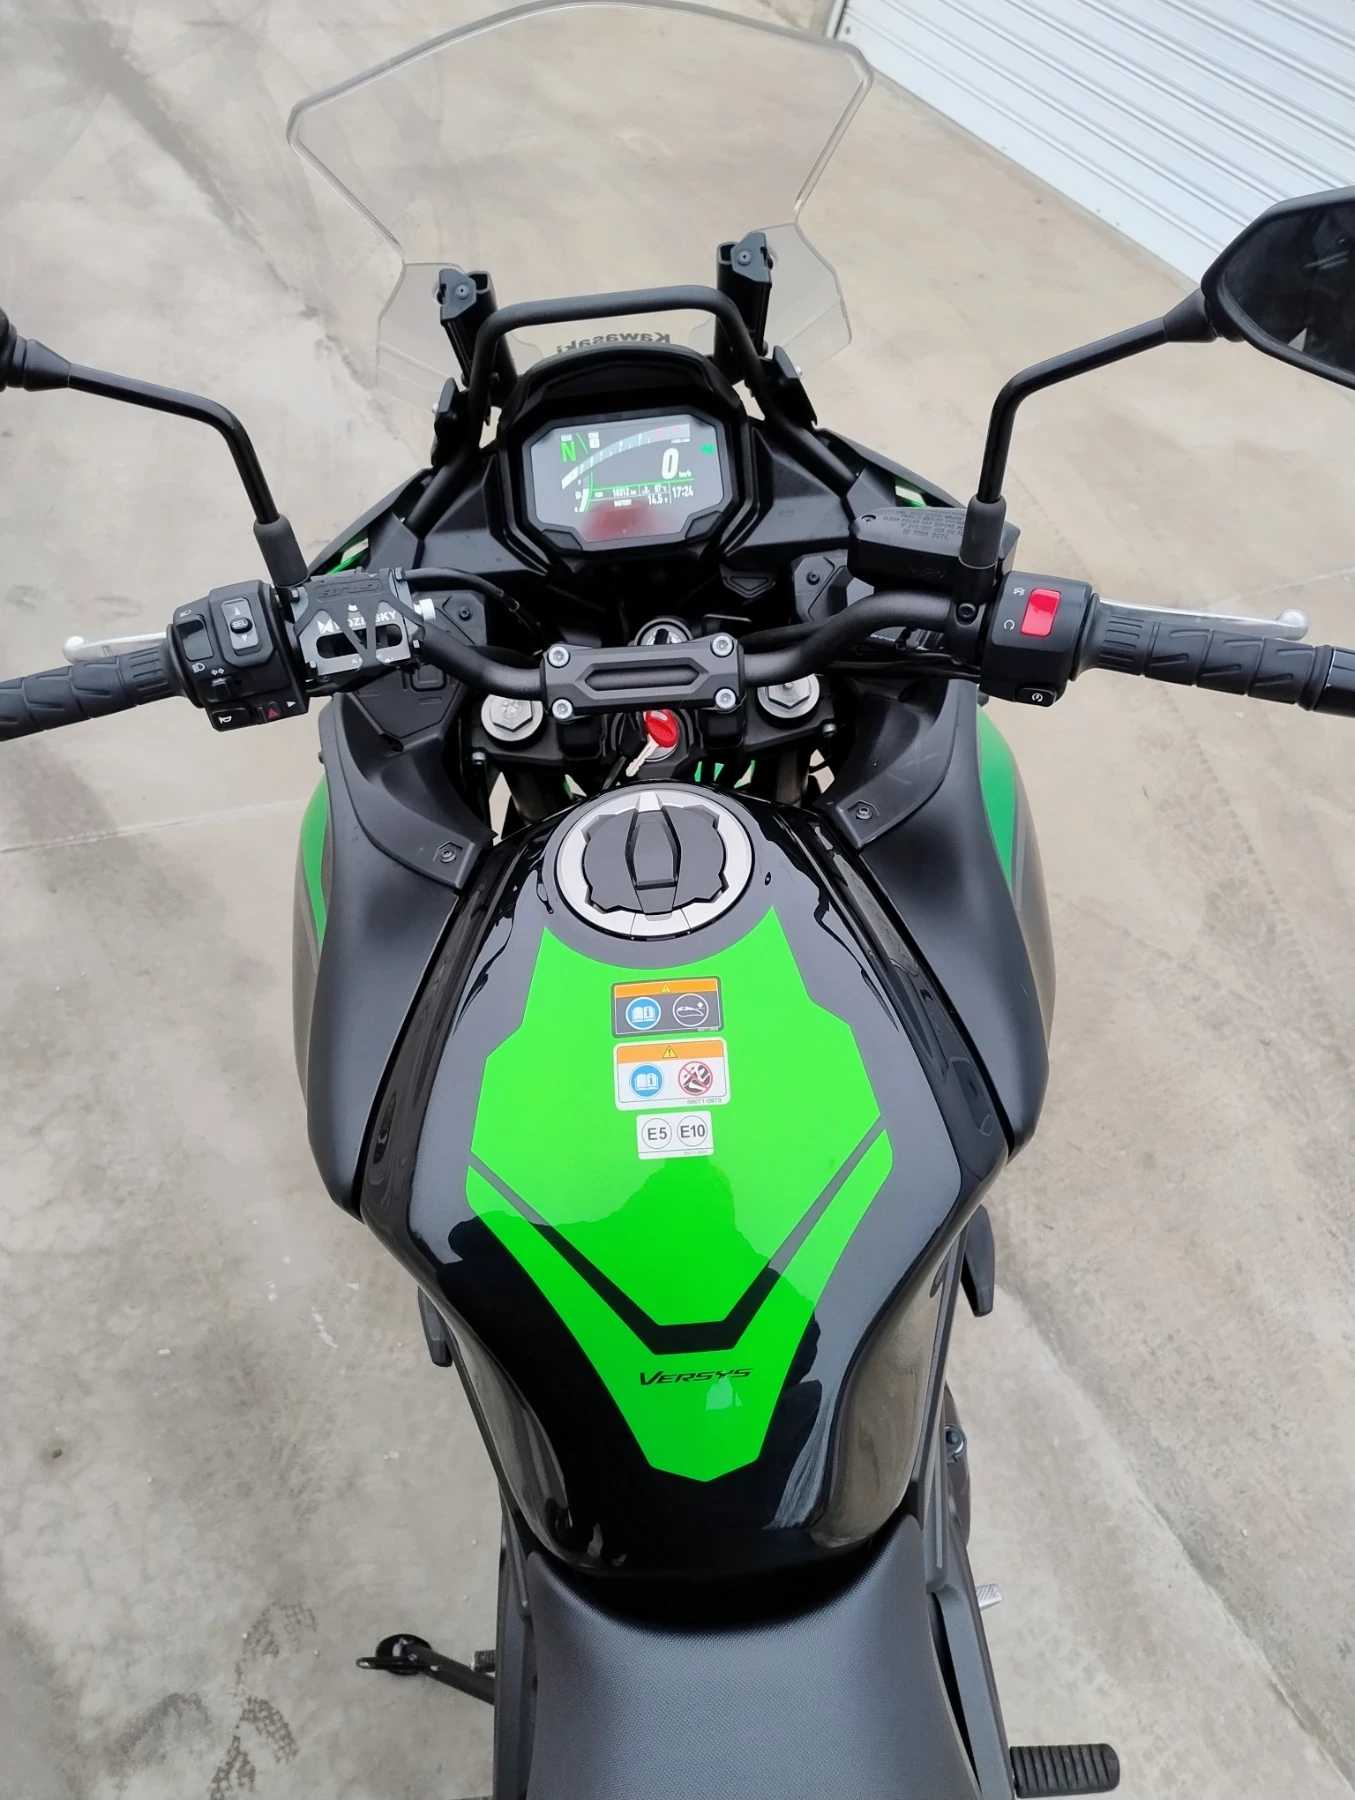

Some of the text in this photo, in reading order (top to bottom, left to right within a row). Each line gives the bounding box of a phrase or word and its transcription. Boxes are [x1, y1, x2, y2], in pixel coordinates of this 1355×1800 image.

[561, 441, 577, 462] N
[661, 447, 680, 480] 0
[232, 619, 249, 628] SEL
[680, 1123, 706, 1139] E10
[639, 1367, 754, 1386] VERSYS
